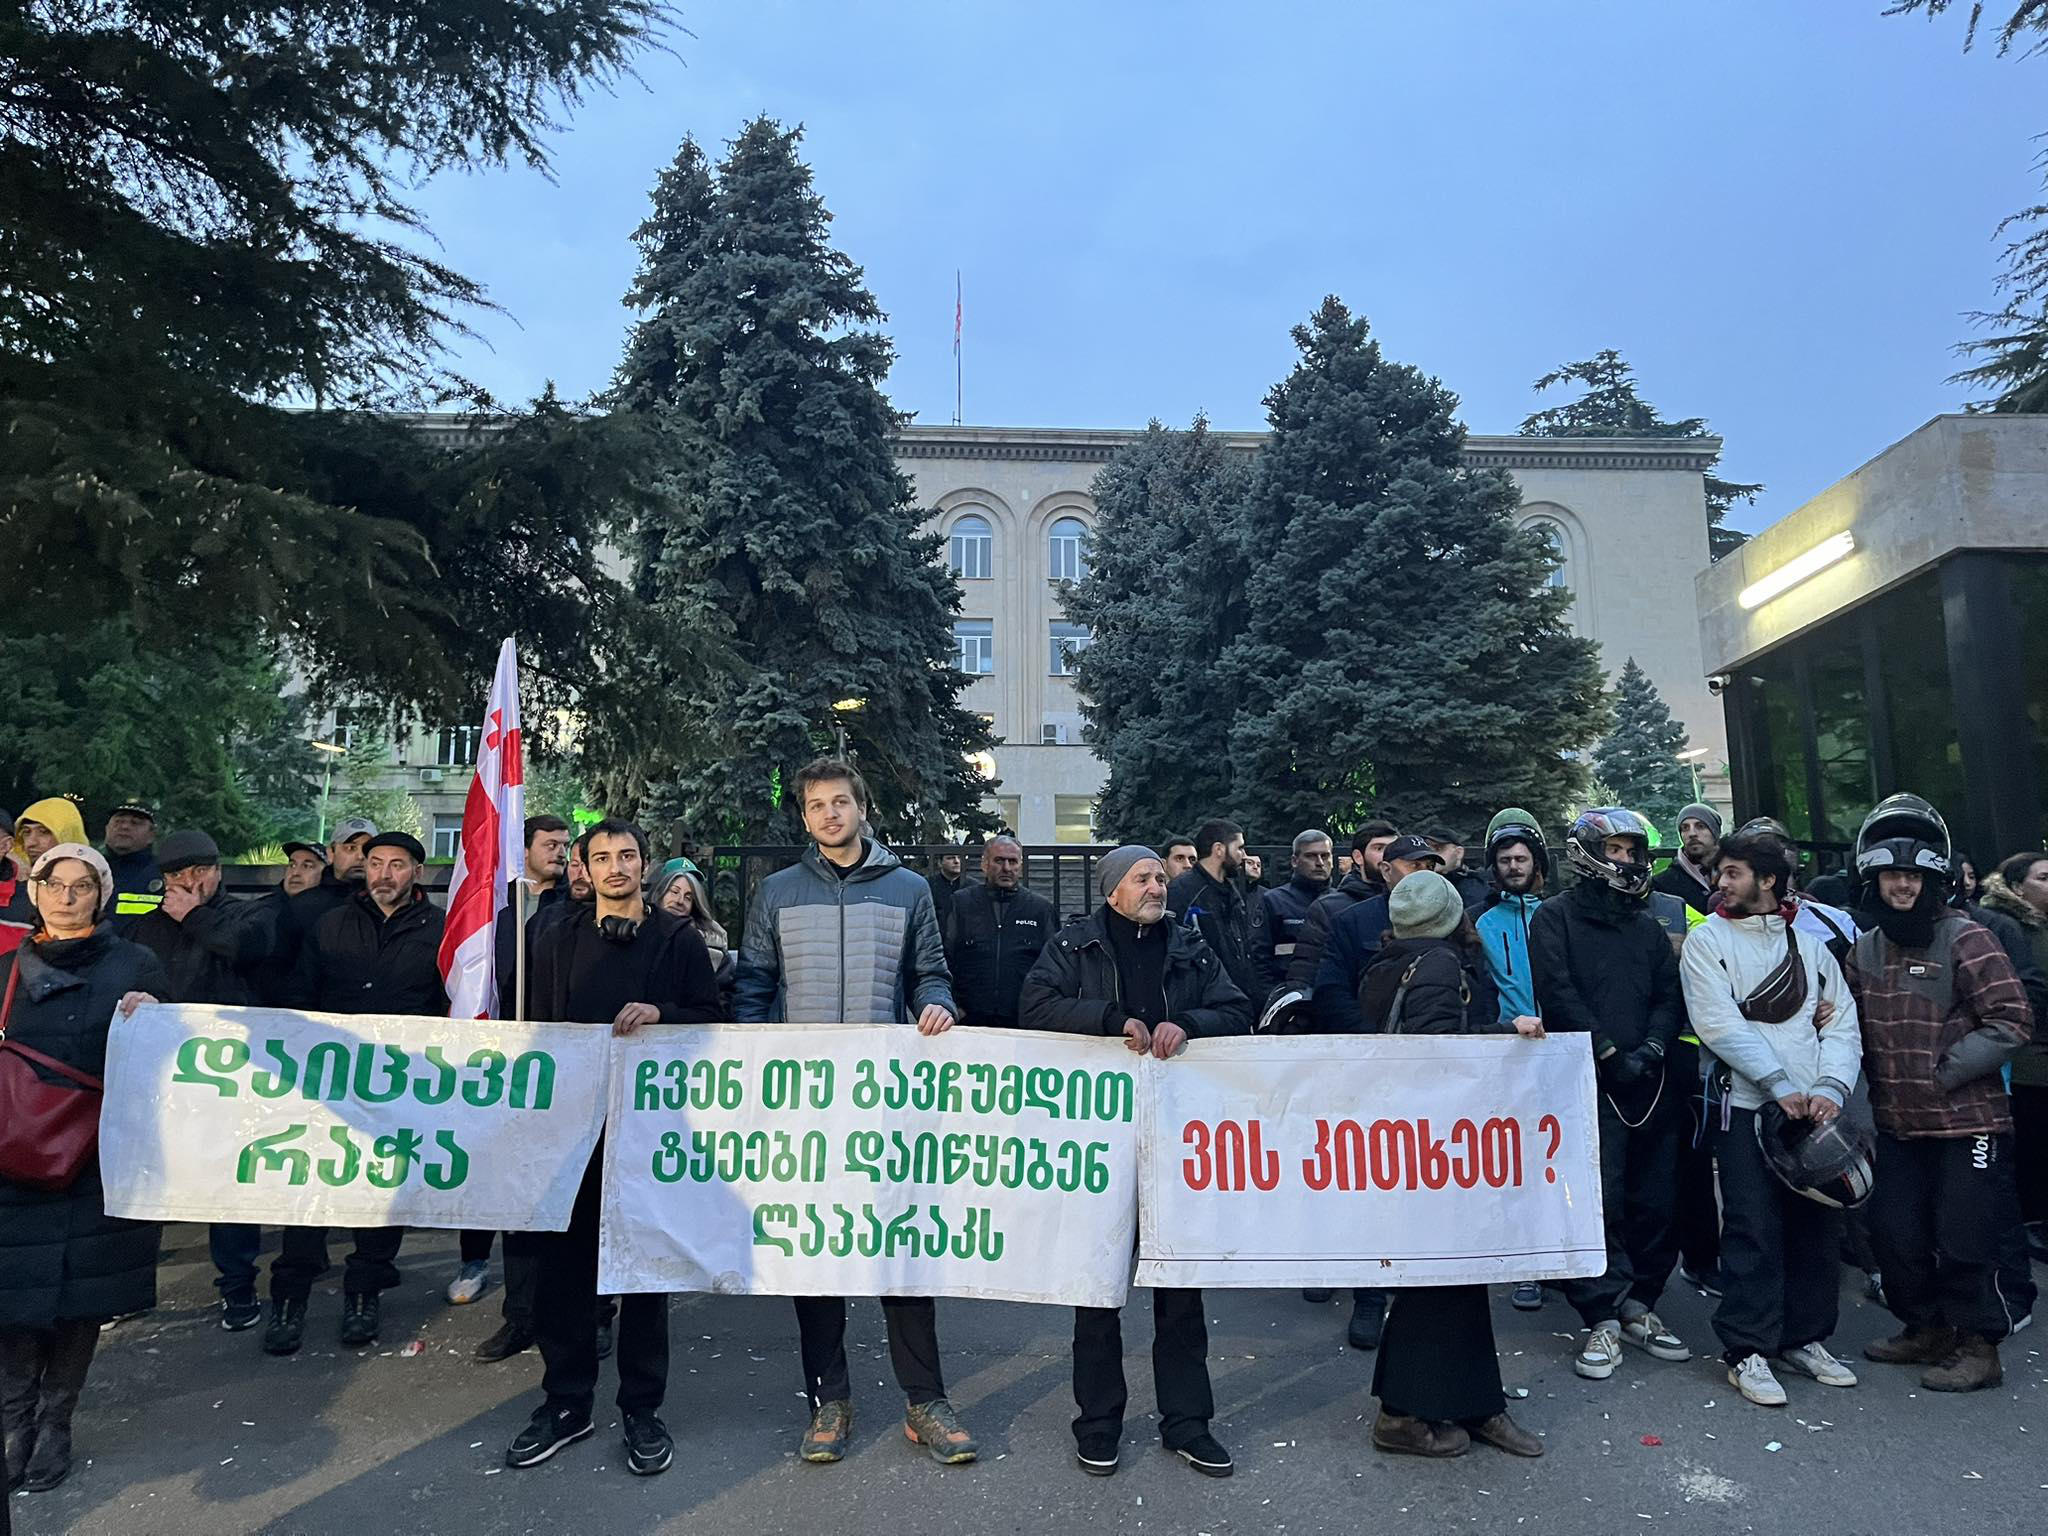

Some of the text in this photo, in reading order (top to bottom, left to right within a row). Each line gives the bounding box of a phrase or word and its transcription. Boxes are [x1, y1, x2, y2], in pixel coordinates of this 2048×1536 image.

[173, 1037, 556, 1110] დაიცავი
[634, 1058, 1135, 1123] ჩვენ თუ გავჩუმდით
[236, 1124, 470, 1191] რაჭა
[652, 1130, 1110, 1194] ტყეები დაიწყებენ
[1182, 1119, 1281, 1192] ვის
[1301, 1117, 1523, 1192] კითხეთ
[1971, 1133, 1989, 1169] Wol
[752, 1203, 1004, 1262] ლაპარაკს
